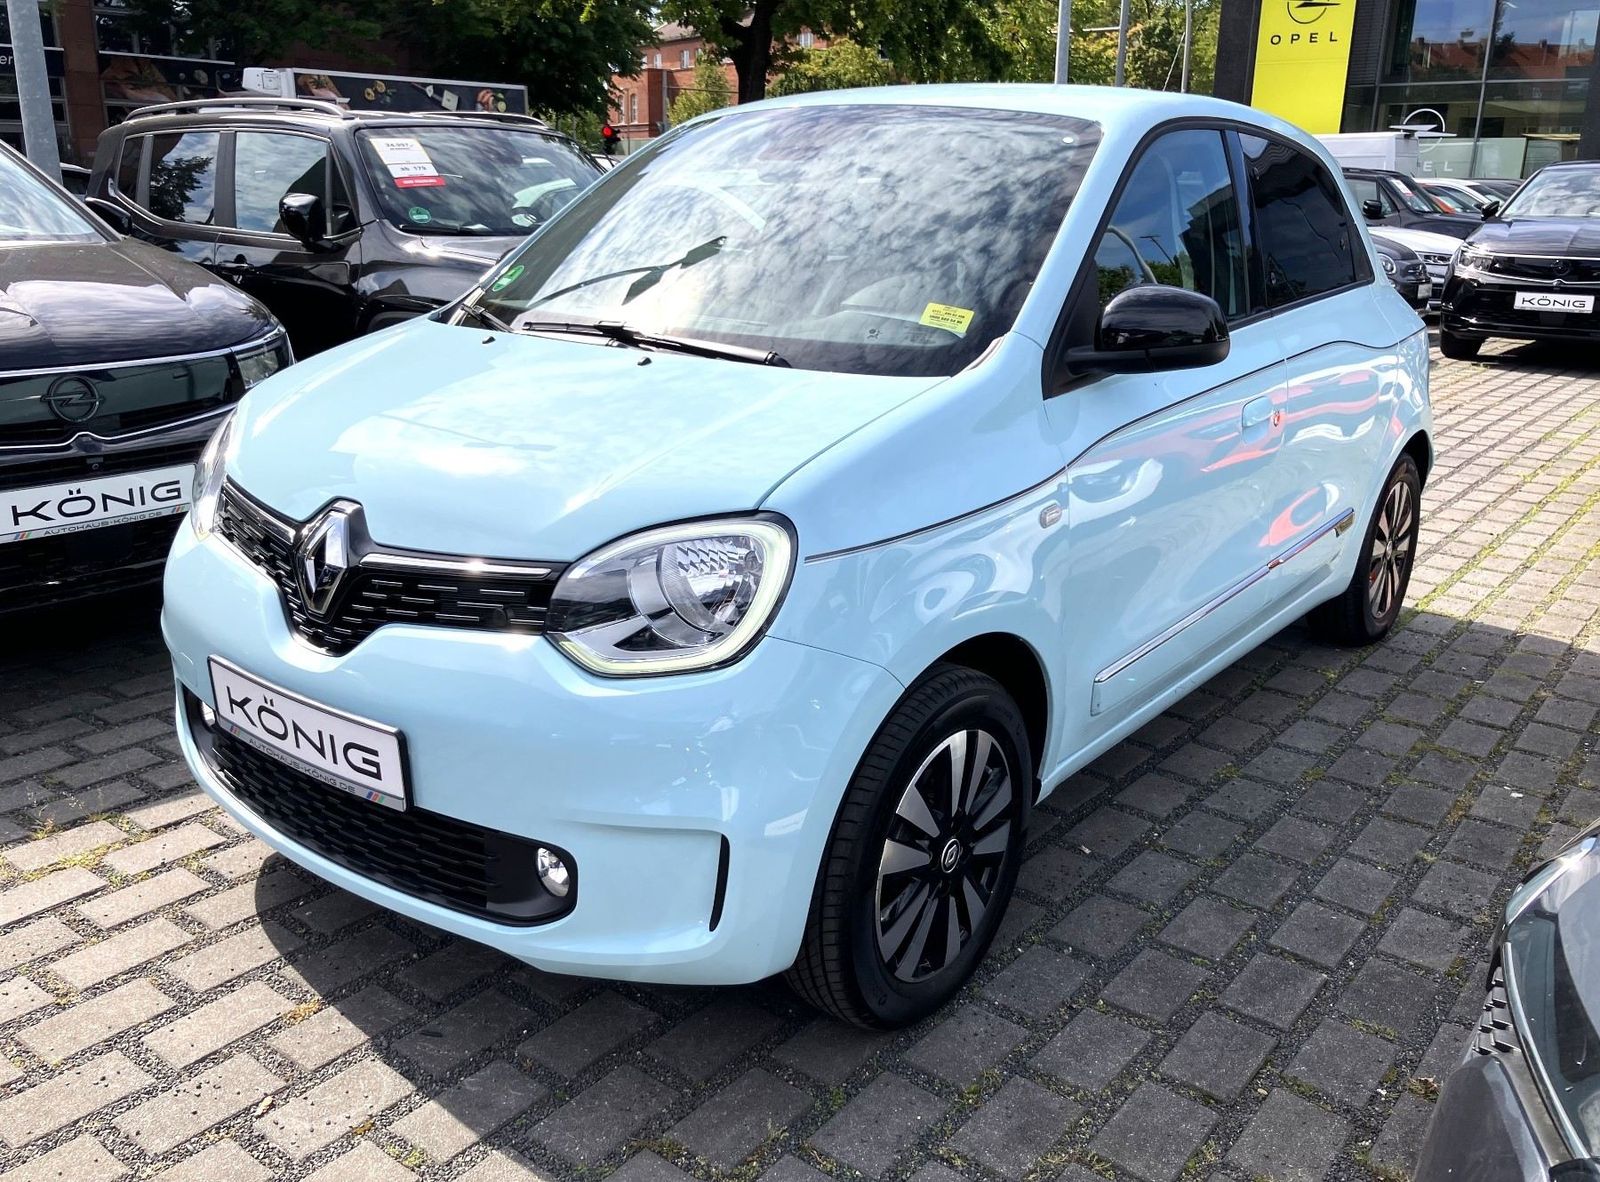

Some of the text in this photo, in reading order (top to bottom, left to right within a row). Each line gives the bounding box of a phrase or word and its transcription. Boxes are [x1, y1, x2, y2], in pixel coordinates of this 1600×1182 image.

[1270, 31, 1338, 46] OPEL
[1521, 295, 1587, 308] KÖNIG
[11, 480, 182, 526] KÖNIG
[226, 685, 383, 781] KÖNIG
